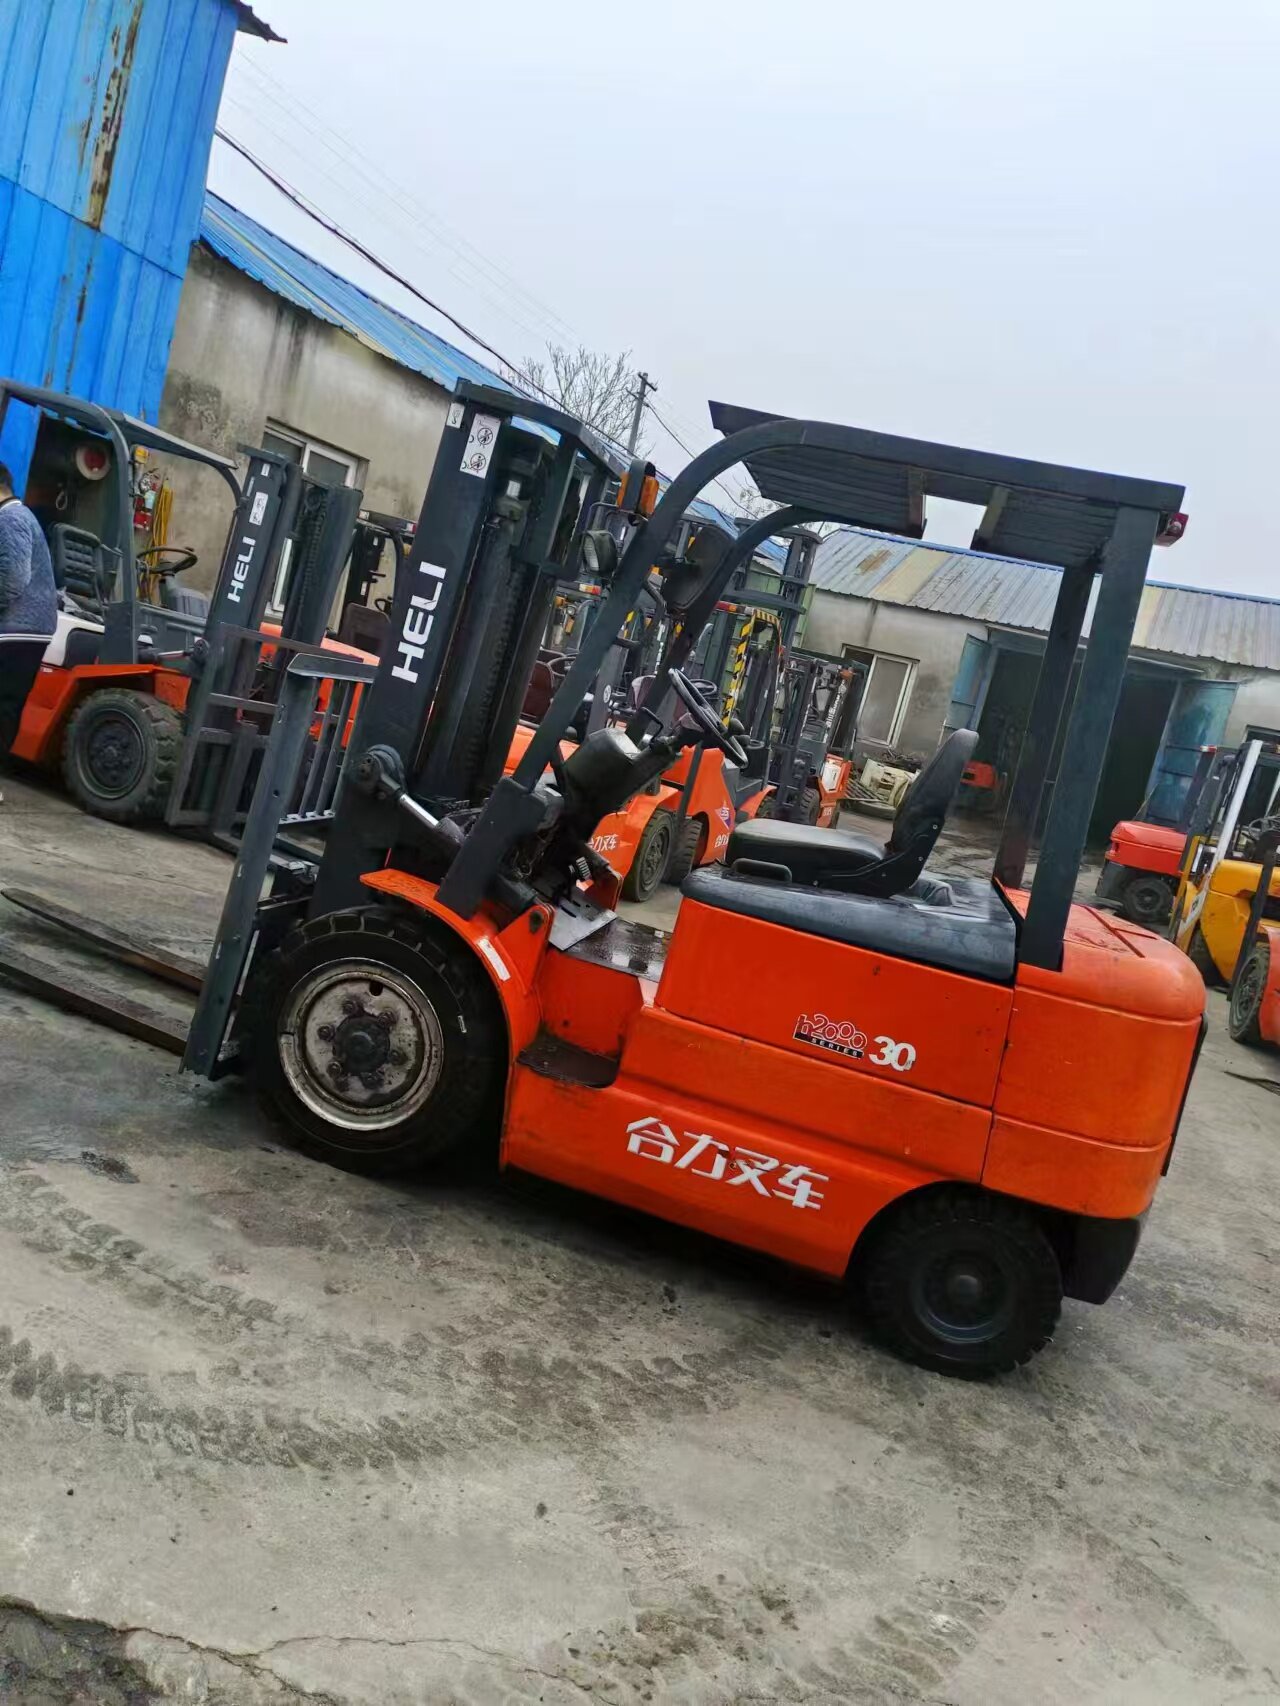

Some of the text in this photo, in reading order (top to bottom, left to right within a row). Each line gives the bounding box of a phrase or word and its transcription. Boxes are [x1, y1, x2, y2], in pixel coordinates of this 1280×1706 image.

[227, 536, 256, 603] HELI
[391, 561, 447, 684] HELI
[811, 1037, 858, 1057] SERIES
[868, 1035, 917, 1072] 30
[625, 1116, 830, 1210] 合力叉车
